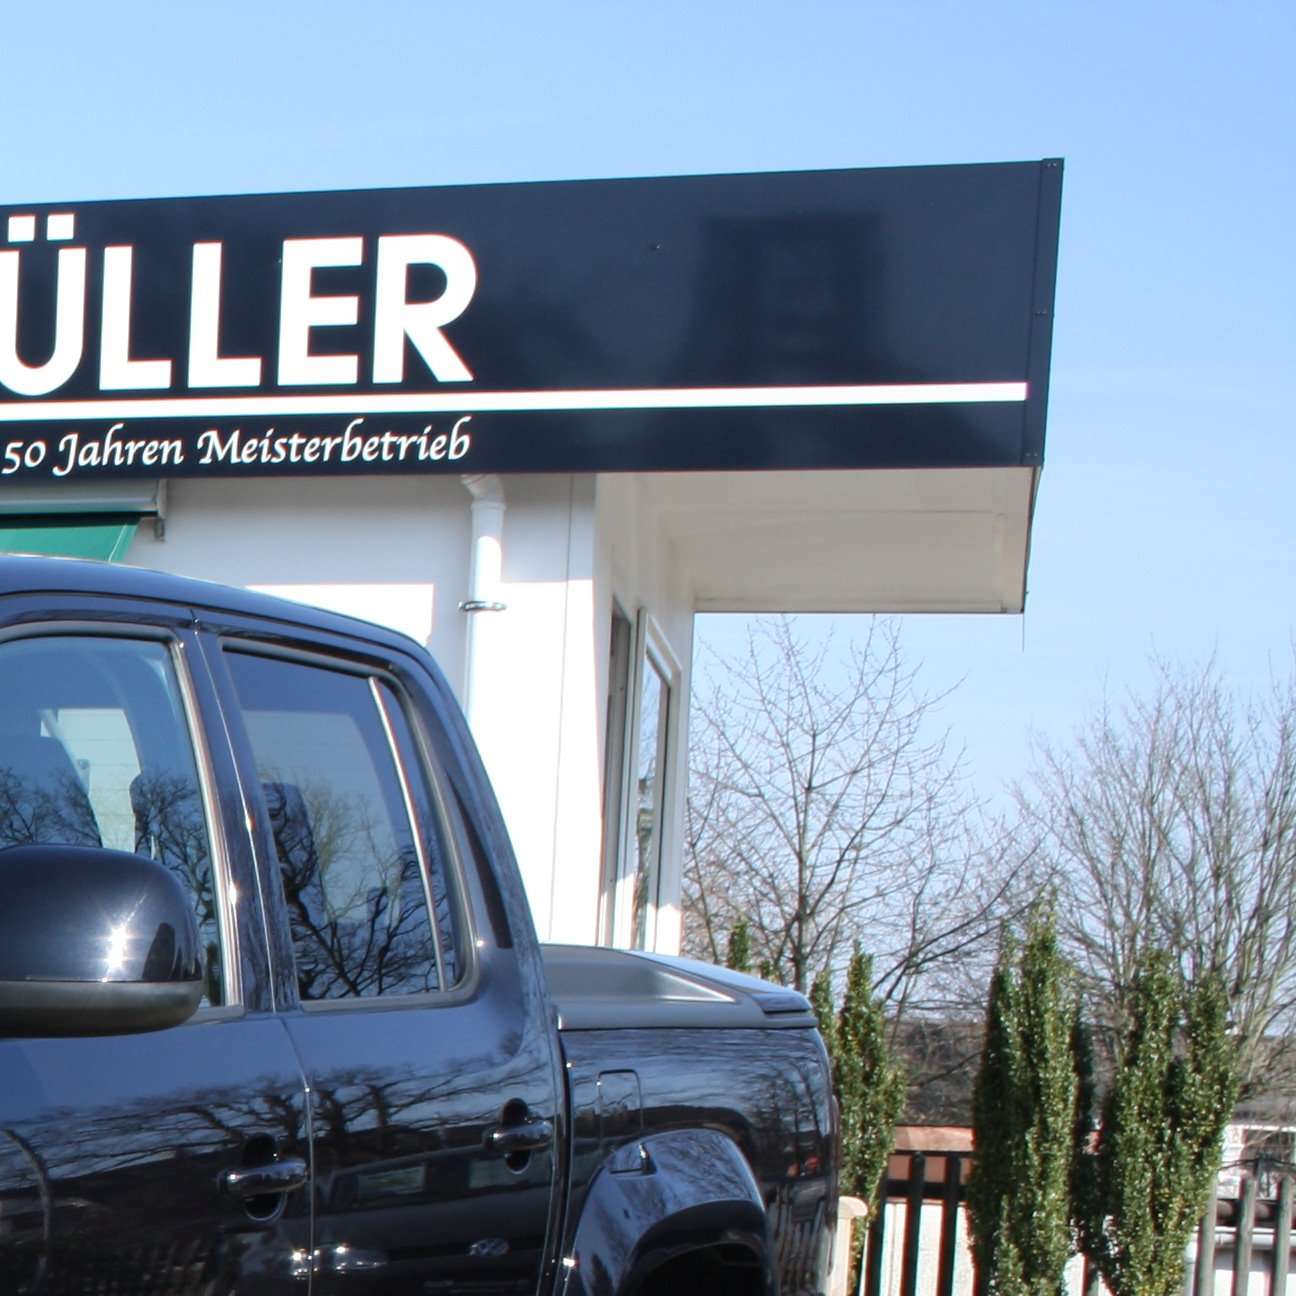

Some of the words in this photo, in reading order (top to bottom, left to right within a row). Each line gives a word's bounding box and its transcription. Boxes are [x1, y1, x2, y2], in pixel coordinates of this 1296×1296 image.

[2, 442, 46, 475] 50
[53, 423, 183, 476] Jahren
[198, 415, 472, 464] Meisterbetrieb
